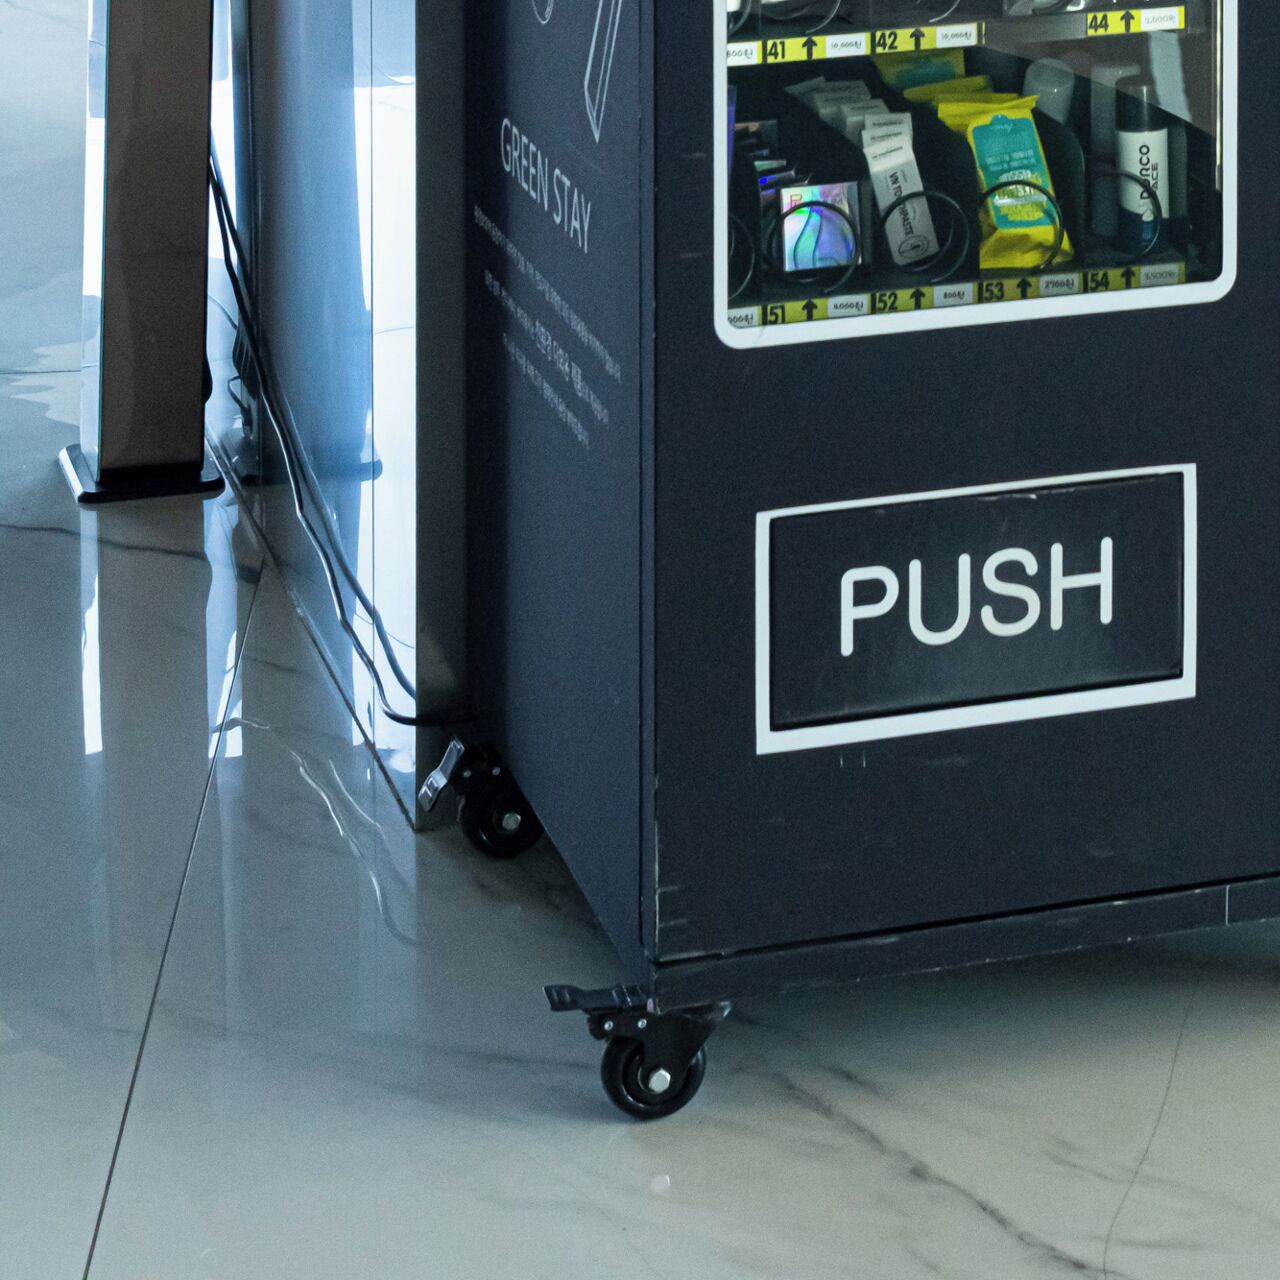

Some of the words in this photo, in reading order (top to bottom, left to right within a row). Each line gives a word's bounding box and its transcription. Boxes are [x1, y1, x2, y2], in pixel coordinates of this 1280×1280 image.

[1088, 13, 1109, 33] 44
[768, 41, 786, 60] 41
[877, 31, 898, 51] 42
[501, 117, 548, 212] GREEN
[553, 167, 591, 254] STAY
[985, 281, 1005, 301] 53
[1090, 272, 1109, 292] 54
[878, 292, 898, 311] 52
[769, 305, 785, 325] 51
[840, 536, 1113, 657] PUSH
